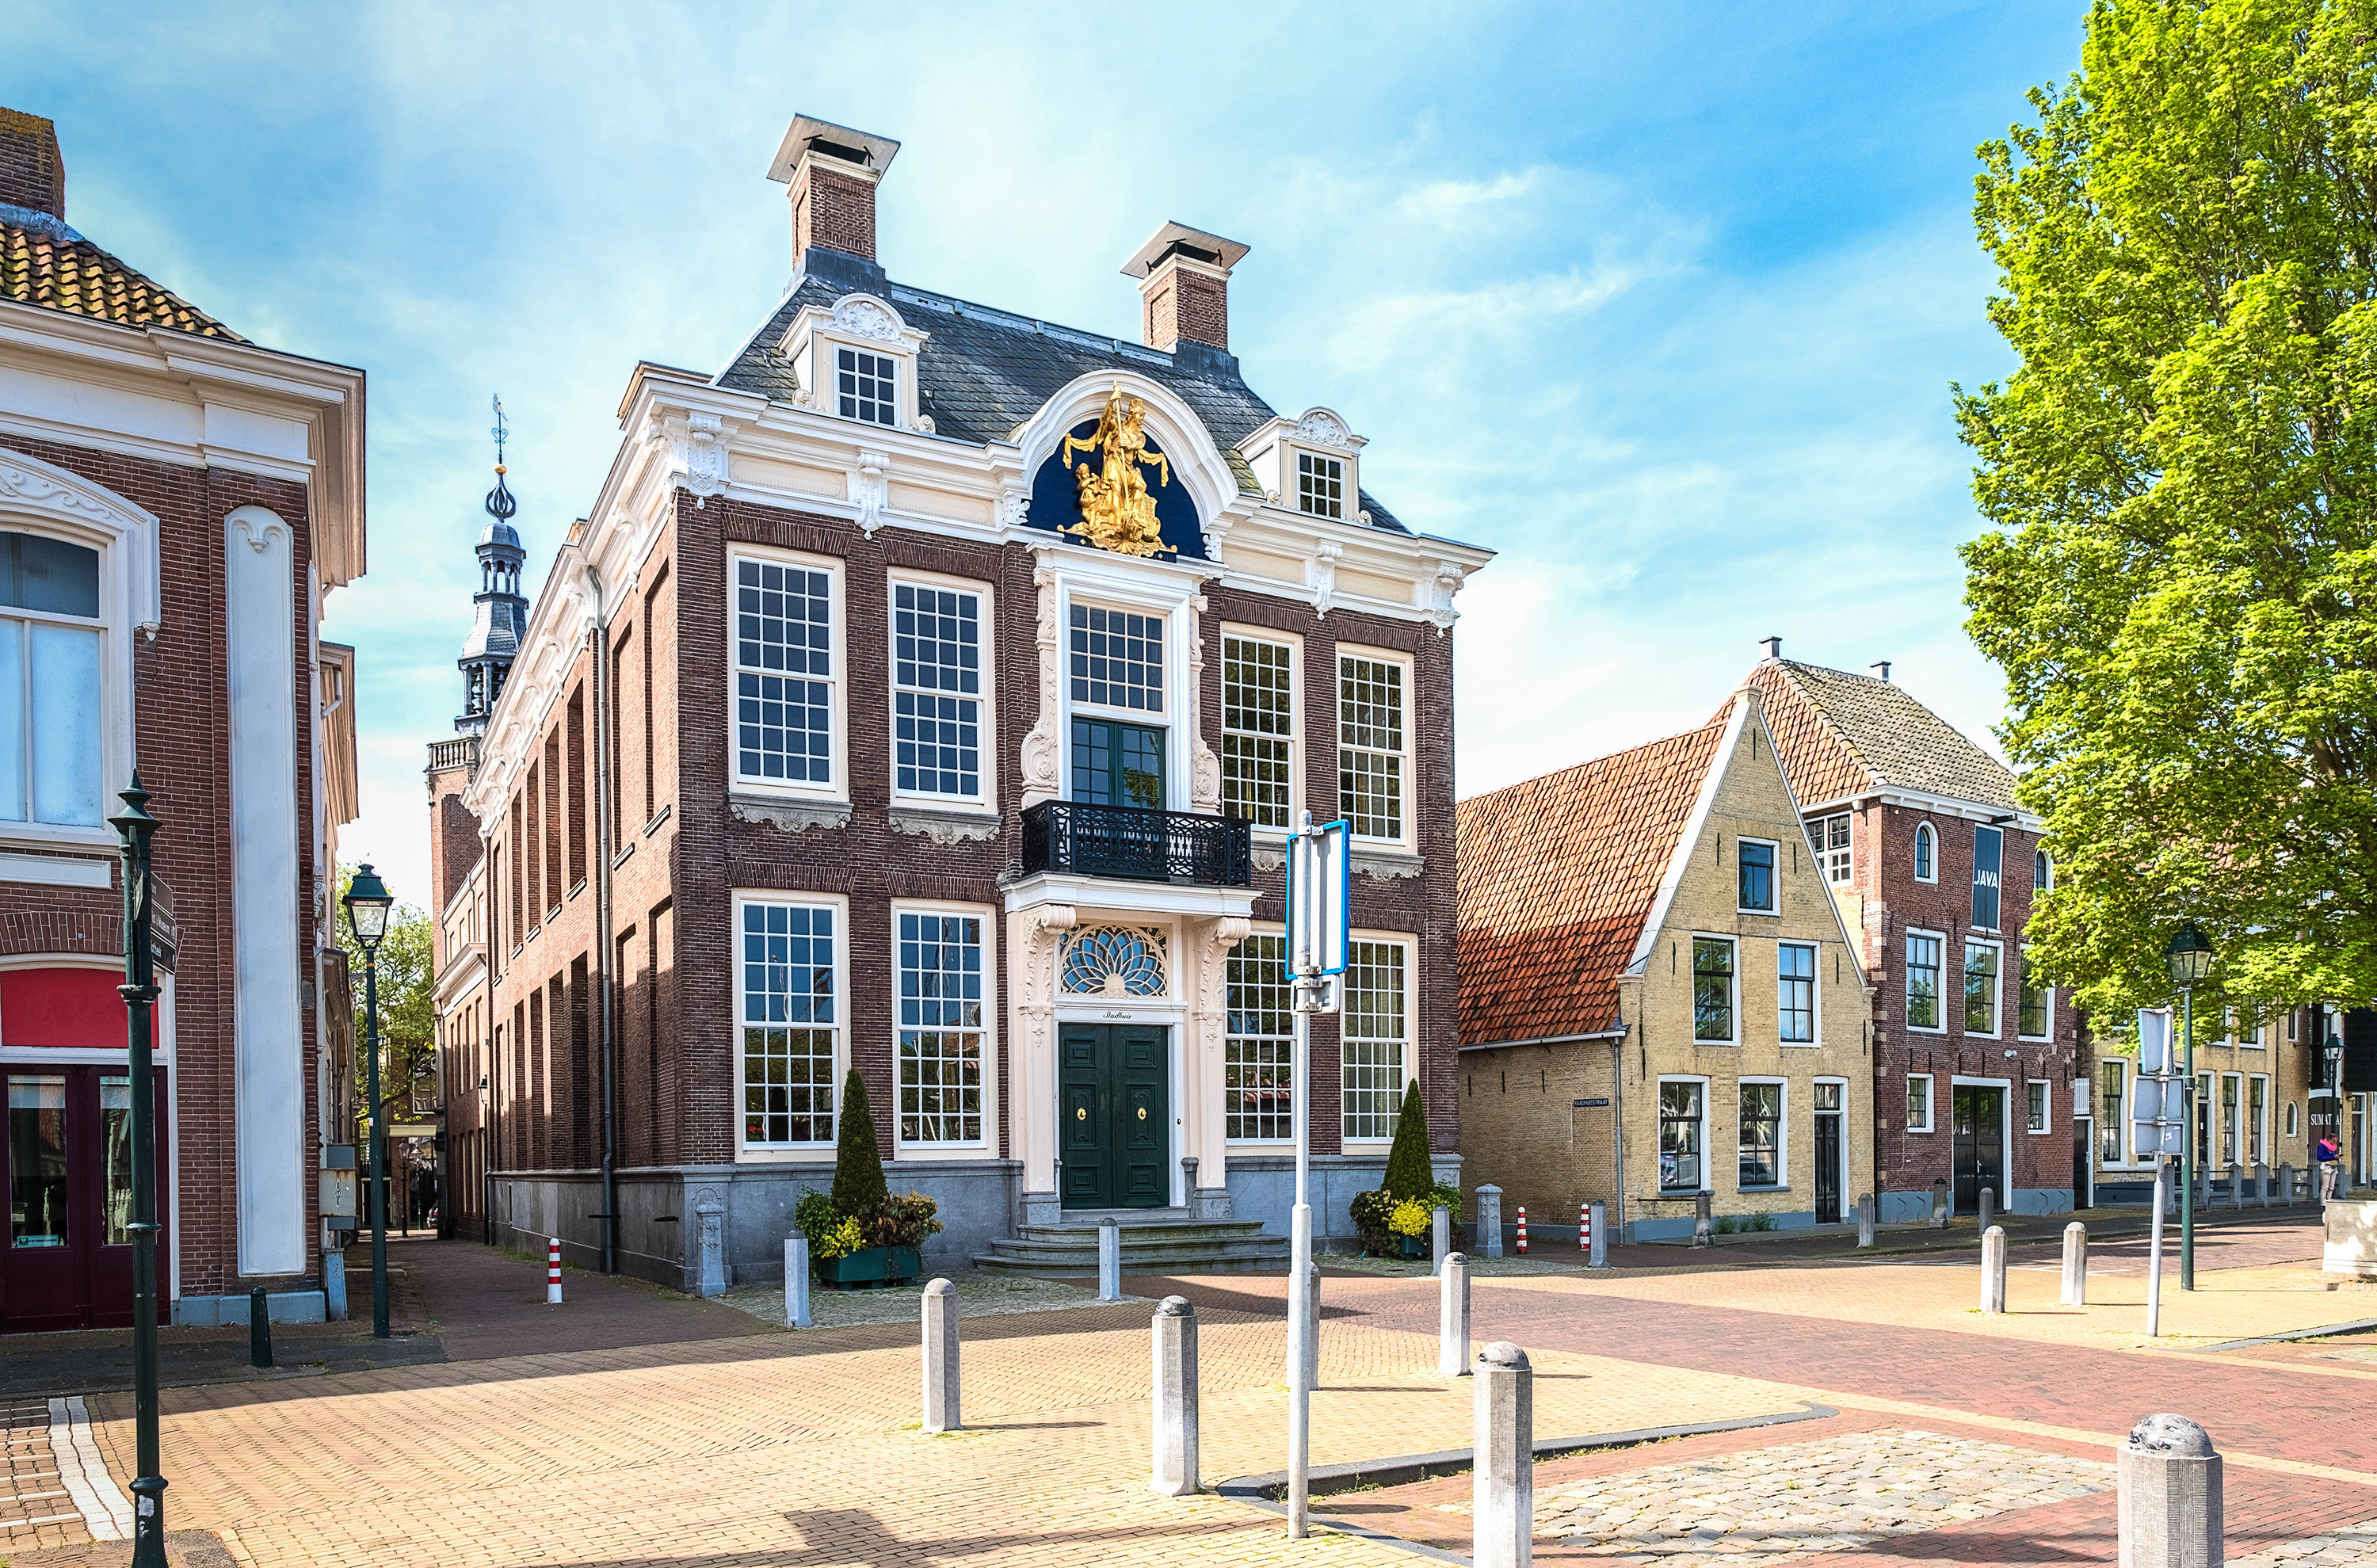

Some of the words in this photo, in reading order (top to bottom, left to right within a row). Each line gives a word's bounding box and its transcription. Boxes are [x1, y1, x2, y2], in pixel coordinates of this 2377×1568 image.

[1974, 869, 1998, 889] JAVA
[1102, 1010, 1131, 1019] Stadhuis
[2310, 1113, 2341, 1126] SUMATA
